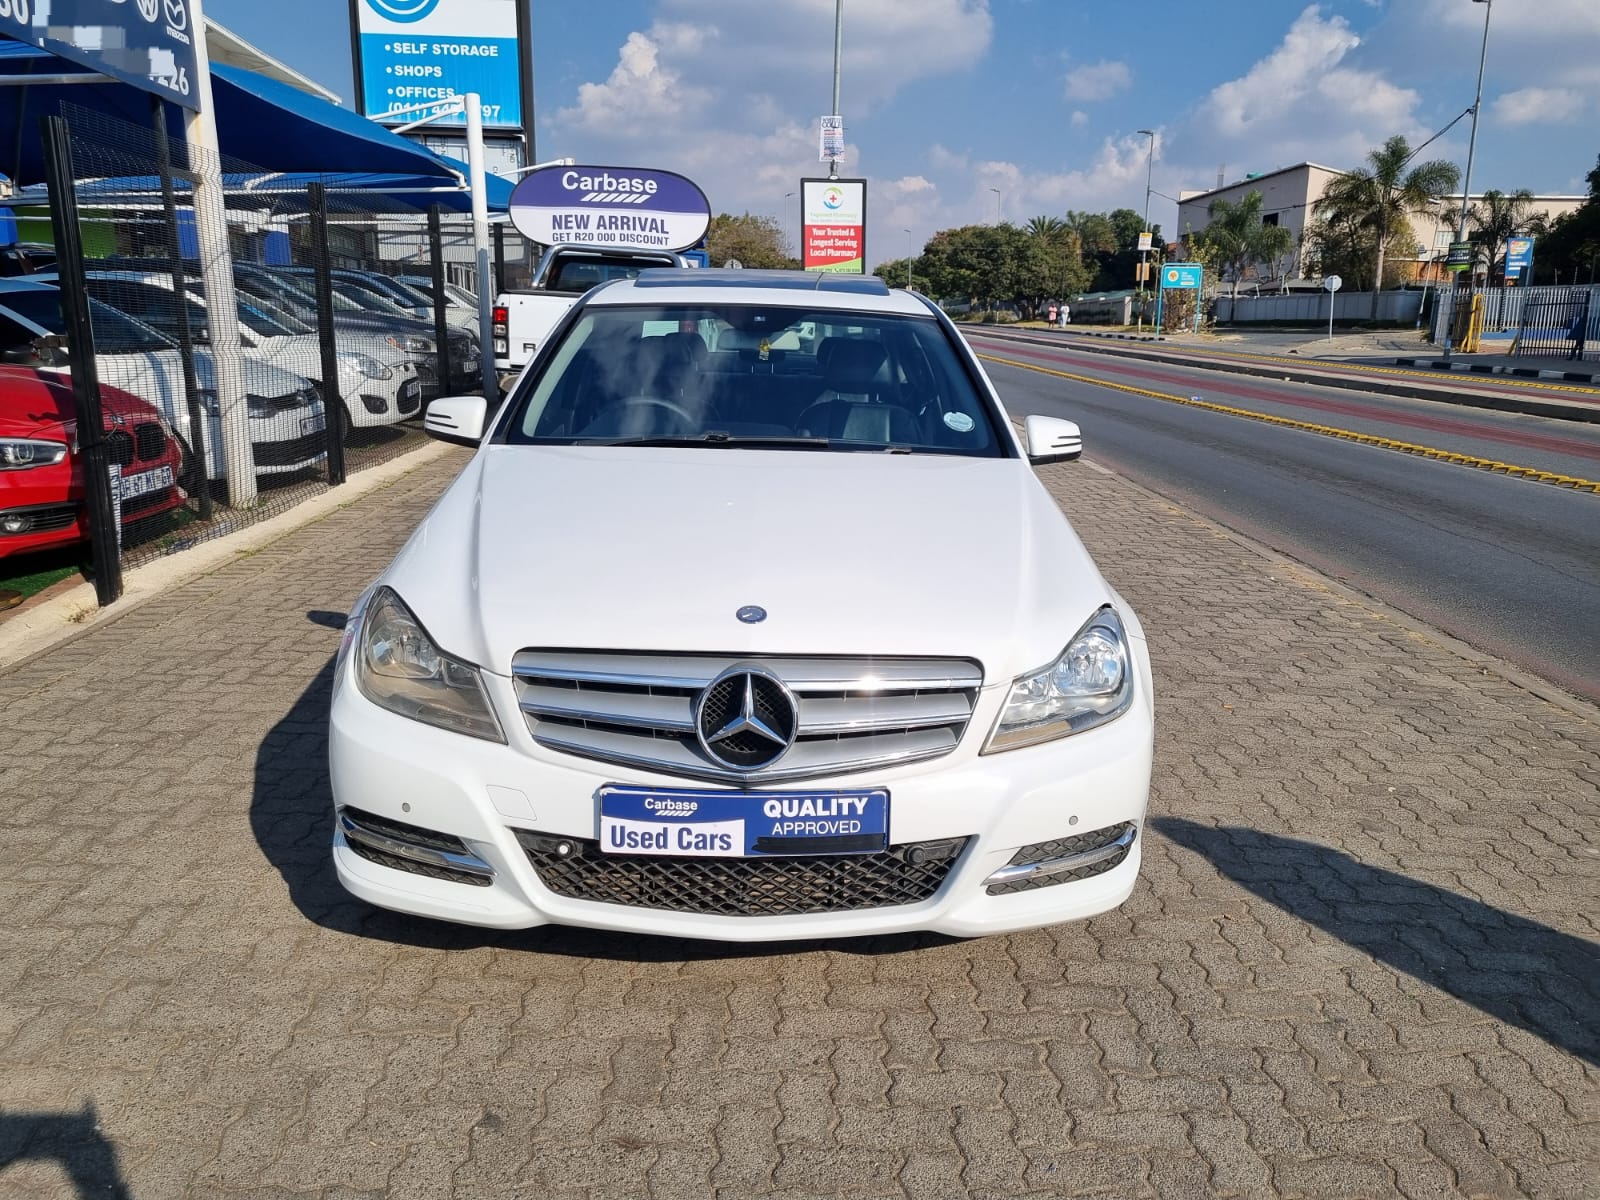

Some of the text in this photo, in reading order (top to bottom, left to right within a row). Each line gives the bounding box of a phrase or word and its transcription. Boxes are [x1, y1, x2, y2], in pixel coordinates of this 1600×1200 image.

[393, 42, 499, 57] SELF STORAGE
[394, 65, 443, 78] SHOPS
[396, 86, 456, 98] OFFICES
[562, 171, 658, 194] Carbase
[552, 214, 670, 234] NEW ARRIVAL
[552, 232, 670, 246] GET R20 000 DISCOUNT
[812, 228, 826, 236] Your
[827, 228, 849, 236] Trusted
[810, 238, 858, 248] Longest Serving
[810, 249, 857, 259] Local Pharmacy
[644, 798, 698, 811] Carbase
[763, 797, 869, 819] QUALITY
[771, 820, 861, 835] APPROVED
[610, 825, 732, 851] Used Cars
